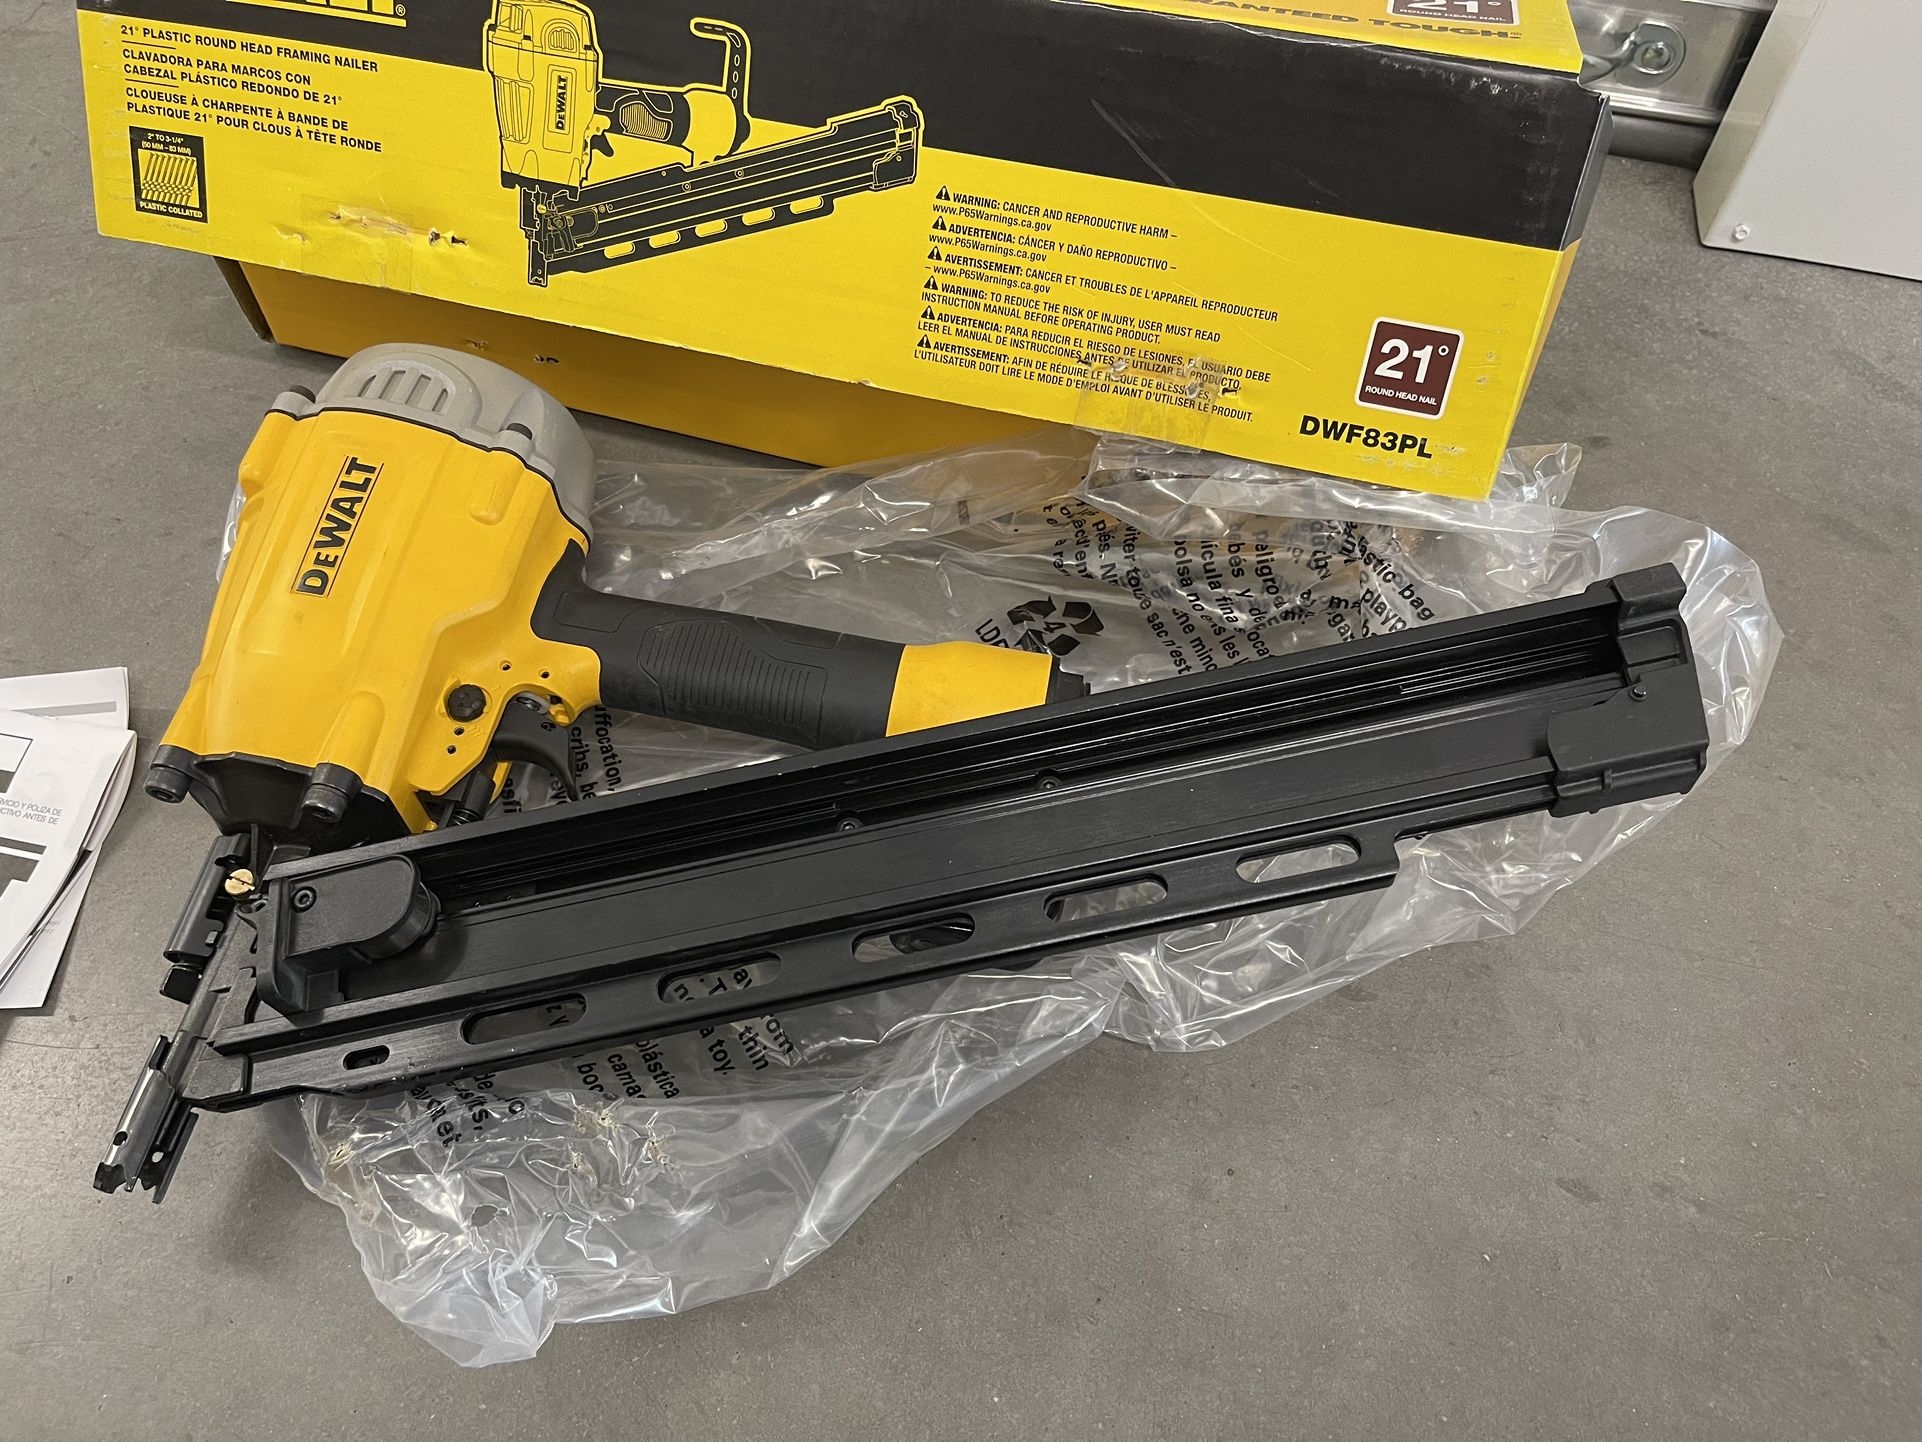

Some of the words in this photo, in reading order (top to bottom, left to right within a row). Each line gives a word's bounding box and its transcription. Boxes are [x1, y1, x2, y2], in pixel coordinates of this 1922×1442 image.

[1184, 0, 1359, 22] ANTEED
[120, 25, 139, 37] 21°
[143, 29, 191, 45] PLASTIC
[195, 36, 236, 52] ROUND
[240, 42, 273, 57] HEAD
[277, 48, 330, 65] FRAMING
[334, 56, 378, 72] NAILER
[123, 49, 193, 69] CLAVADORA
[196, 59, 227, 74] PARA
[231, 64, 282, 81] MARCOS
[285, 71, 311, 86] CON
[124, 64, 177, 81] CABEZAL
[181, 72, 238, 90] PLÁSTICO
[241, 81, 300, 99] REDONDO
[303, 89, 320, 102] DE
[323, 92, 343, 106] 21°
[555, 74, 568, 130] DEWALT
[125, 87, 187, 106] CLOUEUSE
[190, 94, 199, 108] À
[202, 99, 273, 119] CHARPENTE
[276, 107, 285, 121] À
[288, 111, 328, 128] BANDE
[332, 118, 348, 131] DE
[127, 102, 190, 122] PLASTIQUE
[194, 112, 213, 125] 21°
[216, 116, 249, 131] POUR
[253, 122, 291, 138] CLOUS
[295, 126, 304, 140] À
[306, 129, 337, 145] TÊTE
[340, 135, 382, 152] RONDE
[155, 133, 165, 142] TO
[139, 201, 167, 212] PLASTIC
[168, 206, 203, 218] COLLATED
[932, 203, 1052, 232] www.P65Warnings.ca.gov
[952, 192, 1000, 208] WARNING:
[1003, 201, 1040, 216] CANCER
[1042, 208, 1063, 220] AND
[1065, 211, 1137, 233] REPRODUCTIVE
[1139, 224, 1169, 239] HARM
[928, 234, 1047, 262] www.P65Warnings.ca.gov
[948, 223, 1016, 244] ADVERTENCIA:
[1018, 235, 1055, 251] CÁNCER
[1058, 242, 1065, 252] Y
[1066, 243, 1093, 257] DAÑO
[1095, 248, 1168, 271] REPRODUCTIVO
[933, 265, 1051, 294] www.P65Warnings.ca.gov
[944, 253, 1023, 277] AVERTISSEMENT:
[1025, 268, 1062, 284] CANCER
[1065, 274, 1076, 286] ET
[1079, 277, 1127, 295] TROUBLES
[1129, 286, 1143, 298] DE
[1144, 288, 1199, 308] L'APPAREIL
[1201, 298, 1278, 322] REPRODUCTEUR
[921, 291, 981, 311] INSTRUCTION
[983, 303, 1021, 319] MANUAL
[1024, 310, 1059, 326] BEFORE
[1062, 317, 1113, 335] OPERATING
[1115, 327, 1161, 344] PRODUCT.
[941, 283, 988, 299] WARNING:
[990, 291, 1001, 302] TO
[1004, 294, 1040, 309] REDUCE
[1043, 301, 1060, 313] THE
[1062, 304, 1084, 318] RISK
[1086, 309, 1099, 320] OF
[1101, 311, 1136, 328] INJURY,
[1138, 318, 1163, 332] USER
[1165, 323, 1193, 338] MUST
[1194, 328, 1221, 343] READ
[917, 321, 940, 333] LEER
[942, 325, 953, 336] EL
[955, 327, 993, 343] MANUAL
[995, 335, 1007, 346] DE
[1010, 338, 1082, 360] INSTRUCCIONES
[1083, 351, 1114, 366] ANTES
[1132, 360, 1173, 377] UTILIZAR
[933, 341, 1010, 364] AVERTISSEMENT:
[1012, 356, 1033, 369] AFIN
[1035, 360, 1047, 371] DE
[1049, 363, 1089, 379] RÉDUIRE
[1091, 370, 1102, 382] LE
[1104, 373, 1138, 388] RQUE
[1141, 379, 1153, 391] DE
[937, 312, 1002, 333] ADVERTENCIA:
[1004, 324, 1029, 338] PARA
[1031, 329, 1071, 346] REDUCIR
[1073, 337, 1084, 348] EL
[1086, 339, 1121, 355] RIESGO
[1123, 346, 1136, 358] DE
[1201, 360, 1243, 377] USUARIO
[1245, 368, 1272, 383] DEBE
[1374, 338, 1450, 384] 21°
[978, 361, 1000, 374] DOIT
[1001, 365, 1022, 378] LIRE
[1024, 370, 1035, 381] LE
[1037, 372, 1064, 386] MODE
[1112, 386, 1143, 401] AVANT
[1145, 392, 1195, 411] D'UTILISER
[1197, 402, 1208, 413] LE
[1211, 404, 1254, 422] PRODUIT.
[1365, 385, 1395, 398] ROUND
[1395, 390, 1418, 402] HEAD
[1418, 395, 1437, 406] NAIL
[1299, 415, 1433, 459] DWF83PL
[296, 456, 377, 596] DEWALT
[1398, 583, 1435, 621] bag
[1147, 612, 1169, 639] sac
[594, 706, 622, 791] uffocation,
[22, 812, 47, 822] ANTES
[48, 816, 60, 825] DE
[52, 808, 63, 817] DE
[708, 1039, 736, 1075] toy.
[738, 1025, 769, 1071] thin
[607, 1053, 647, 1098] cama
